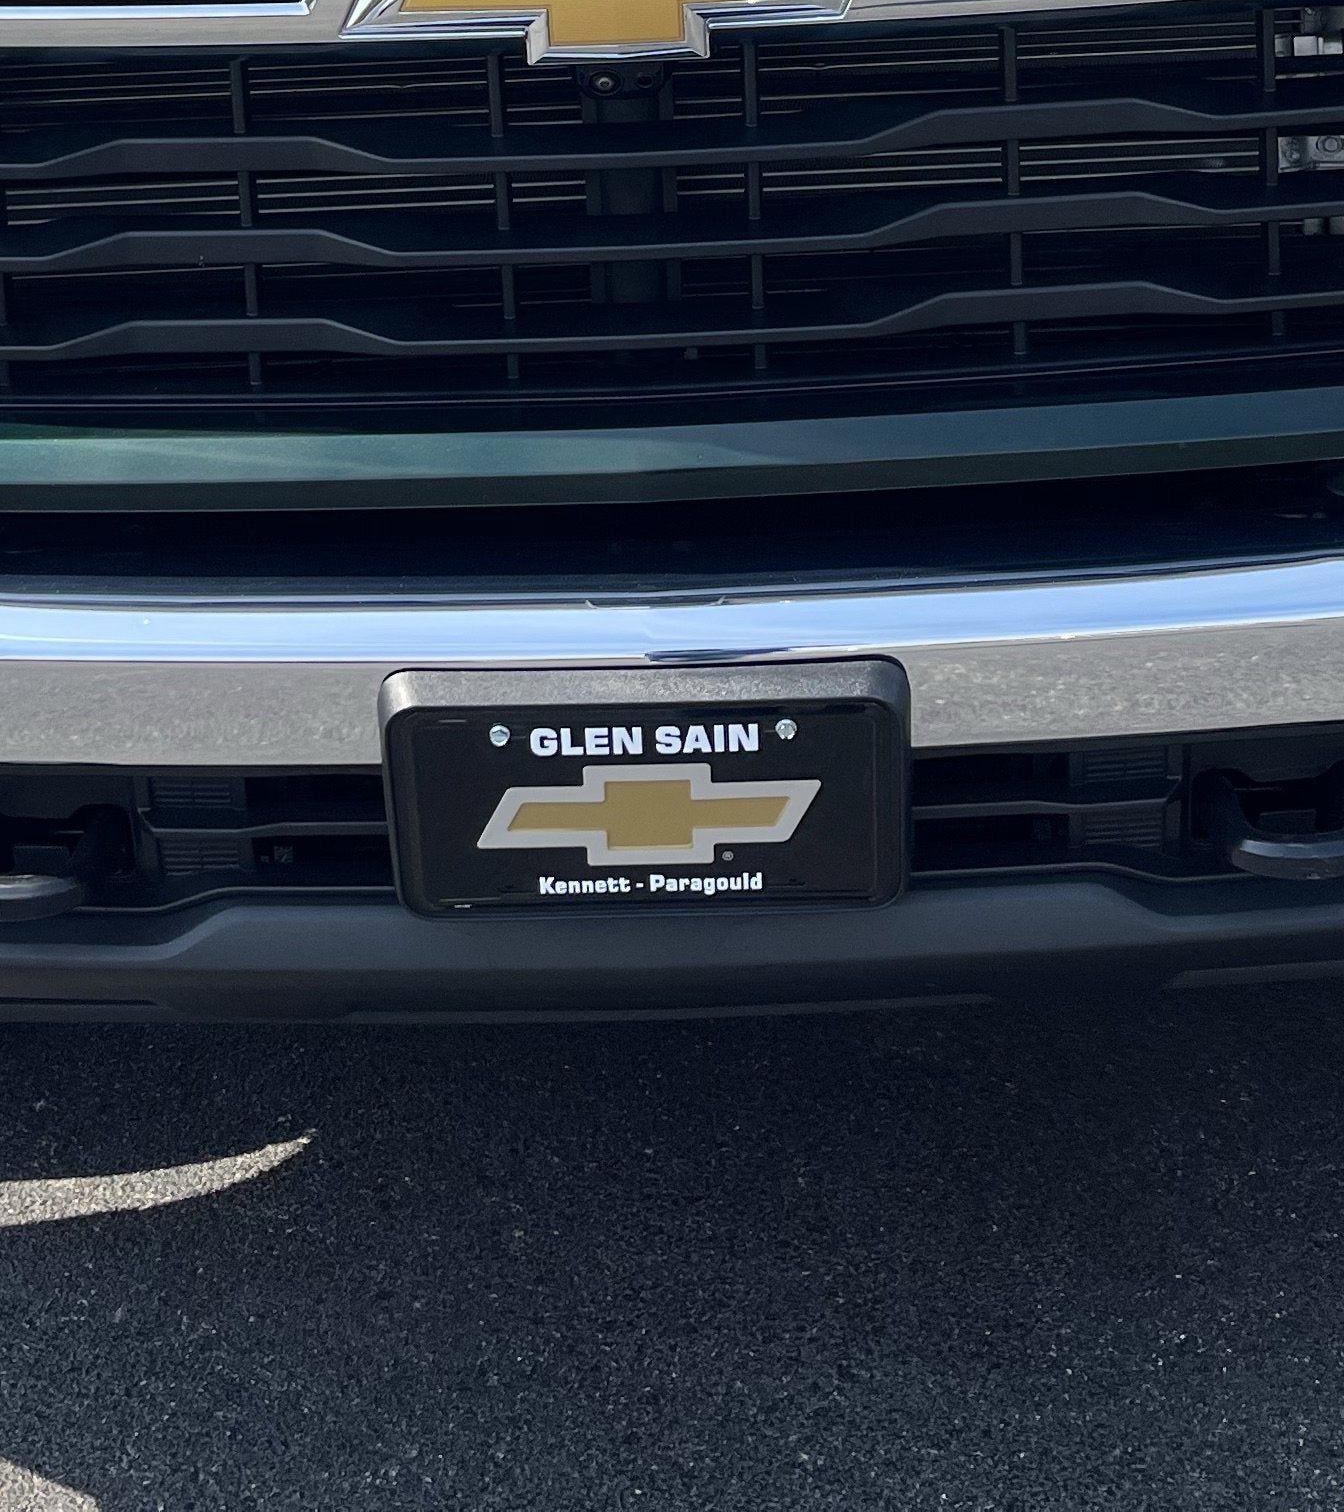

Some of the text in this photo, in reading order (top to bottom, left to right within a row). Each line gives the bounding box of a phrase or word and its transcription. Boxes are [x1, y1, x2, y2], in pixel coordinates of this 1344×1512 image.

[529, 723, 760, 756] GLEN SAIN
[539, 876, 632, 895] Kennett
[649, 872, 763, 896] Paragould
